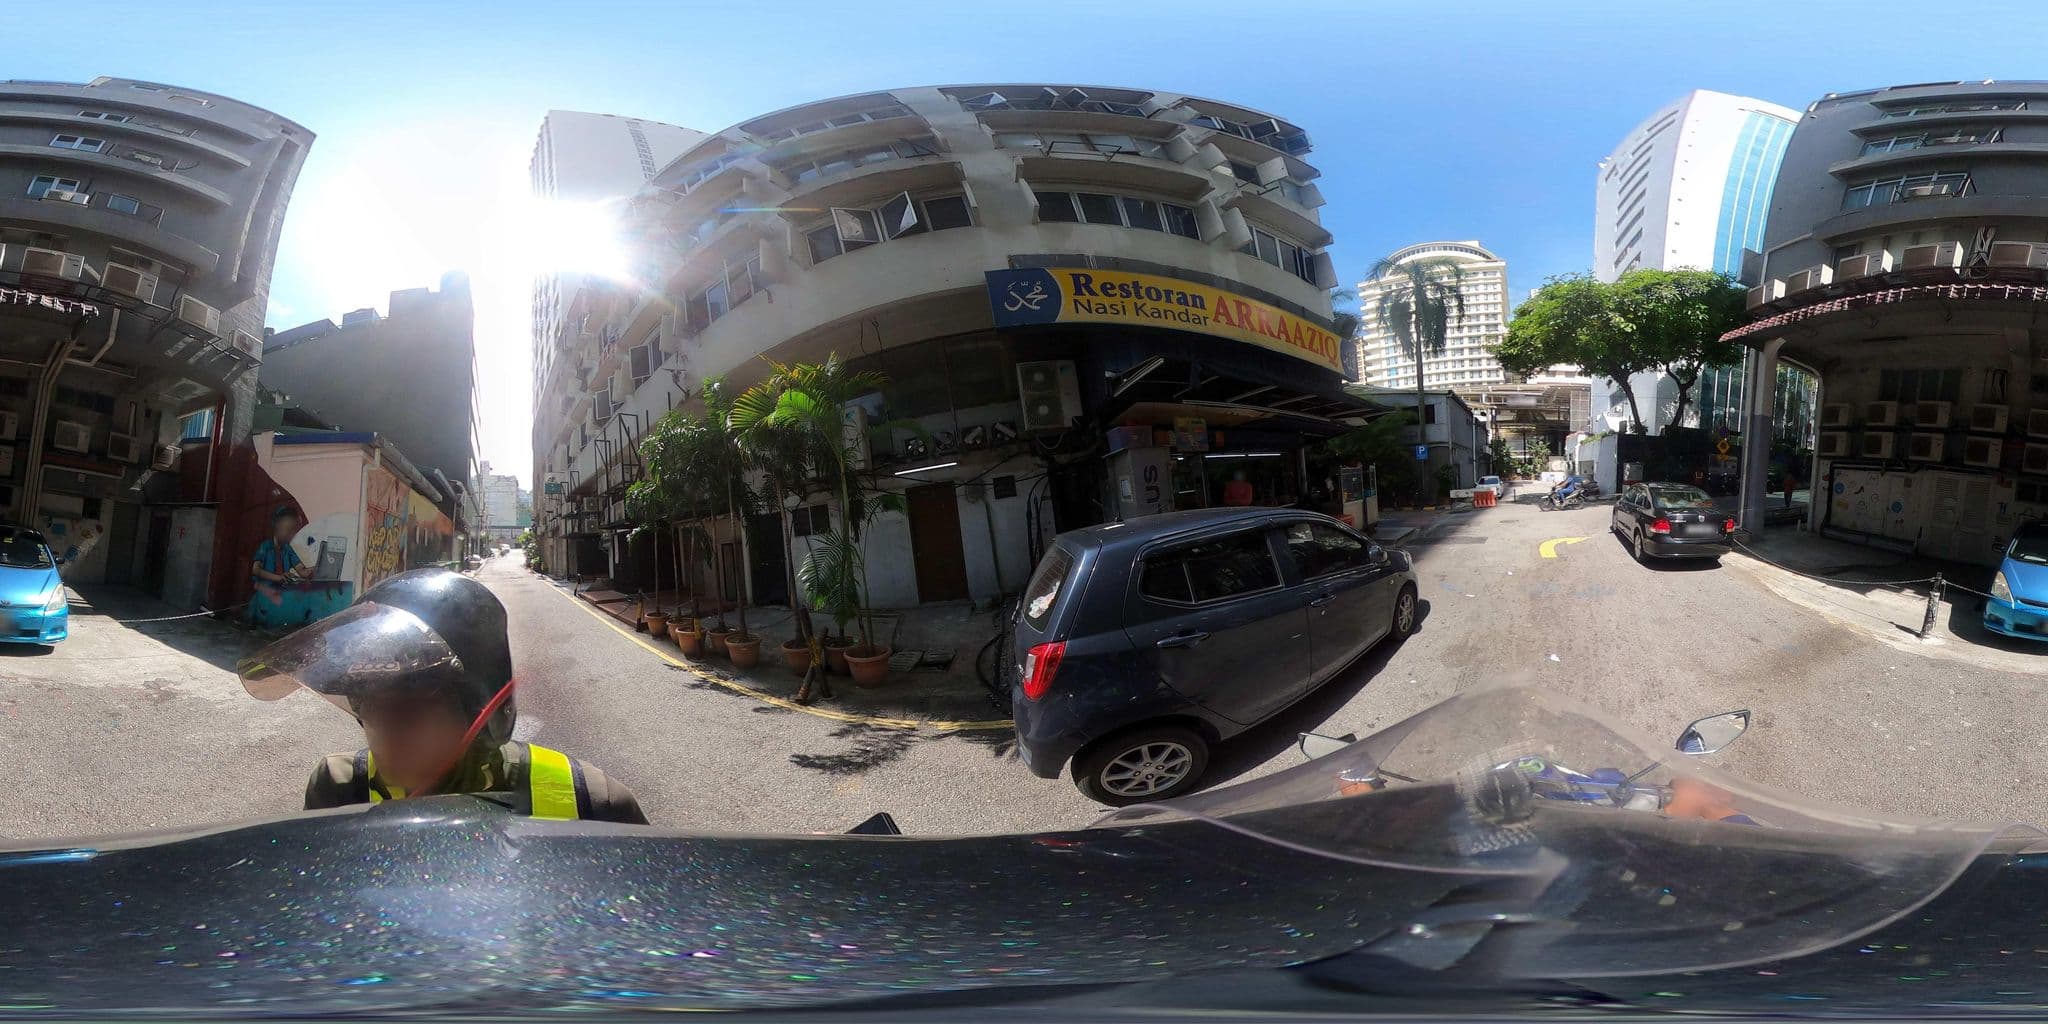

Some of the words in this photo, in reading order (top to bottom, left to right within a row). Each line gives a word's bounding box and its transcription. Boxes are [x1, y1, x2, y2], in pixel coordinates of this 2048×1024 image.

[1069, 273, 1207, 311] Restoran
[1073, 299, 1127, 316] Nasi
[1134, 302, 1210, 326] Kandar
